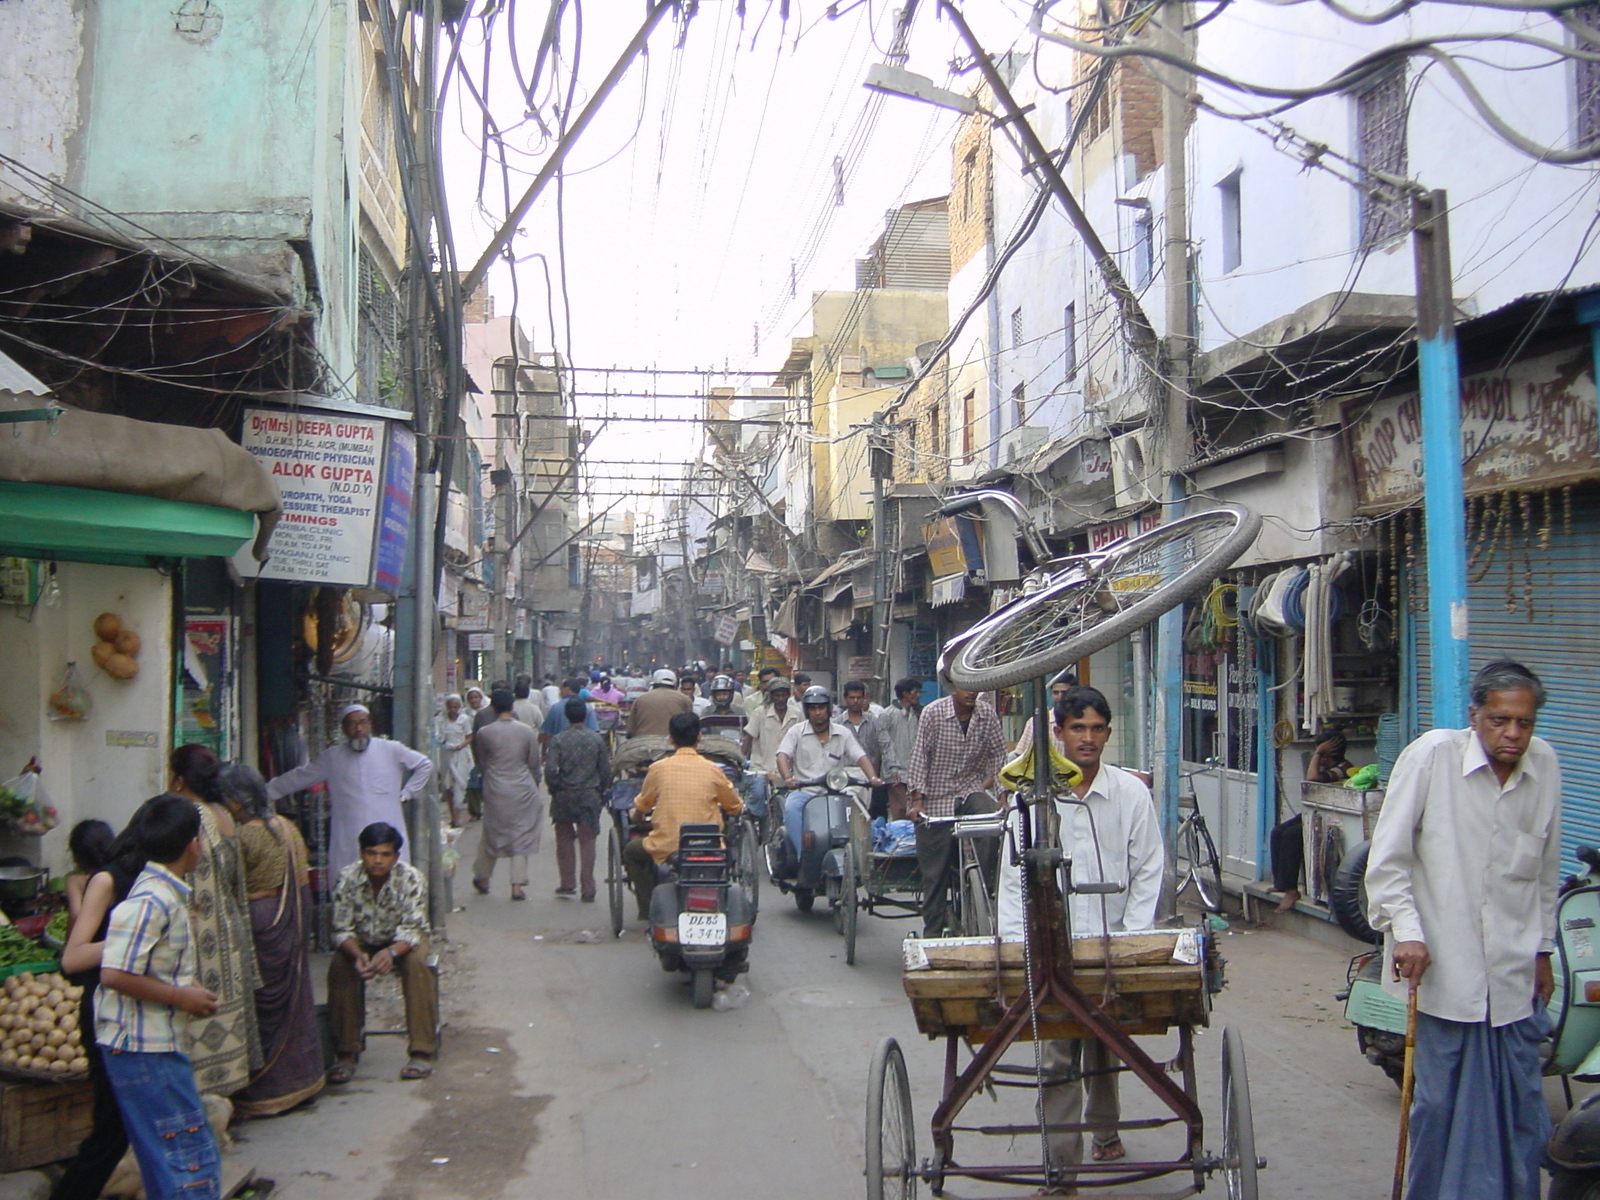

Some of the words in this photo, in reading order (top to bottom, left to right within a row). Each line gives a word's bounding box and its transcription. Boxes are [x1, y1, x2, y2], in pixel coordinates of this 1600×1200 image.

[296, 420, 333, 437] DEEPA
[336, 425, 374, 441] GUPTA
[338, 442, 374, 455] (MUMBAI)
[323, 453, 375, 466] PHYSICIAN
[272, 461, 316, 479] ALOK
[320, 467, 374, 484] GUPTA
[280, 491, 325, 504] UROPATH,
[328, 494, 353, 505] YOGA
[283, 501, 318, 514] ESSURE
[320, 504, 371, 517] THERAPIST
[276, 523, 307, 534] ARIBA
[309, 526, 344, 537] CLINIC
[301, 542, 312, 550] TO
[267, 547, 314, 560] RYAGANJ
[316, 552, 351, 563] CLINIC
[297, 567, 309, 575] TO
[315, 561, 330, 570] SAT
